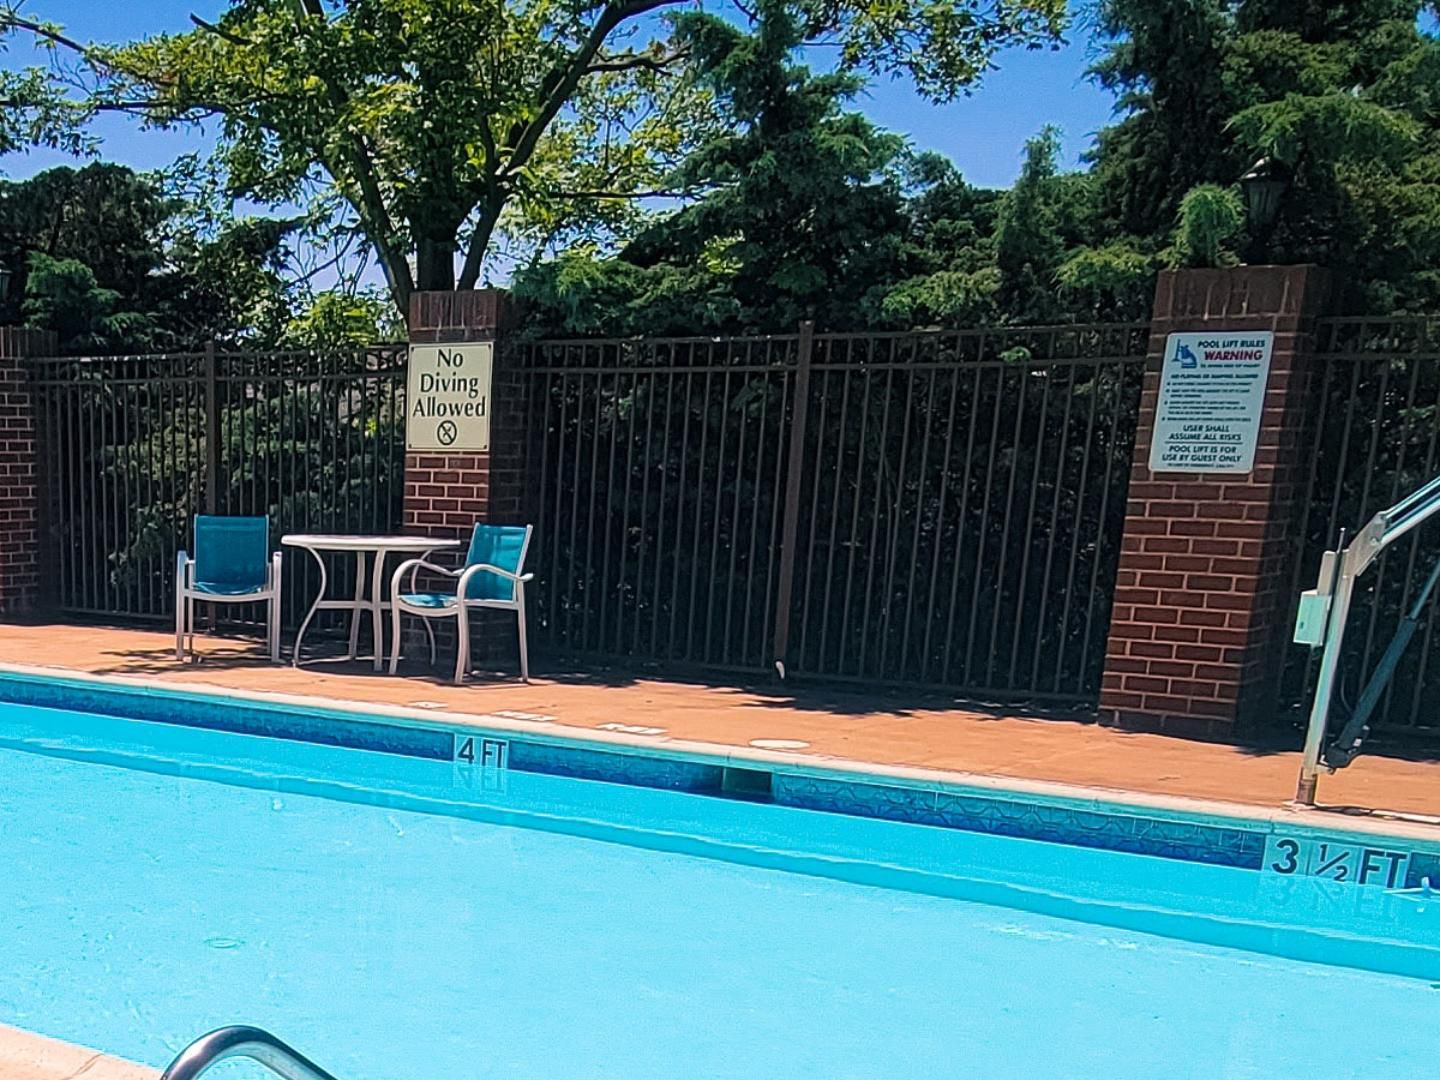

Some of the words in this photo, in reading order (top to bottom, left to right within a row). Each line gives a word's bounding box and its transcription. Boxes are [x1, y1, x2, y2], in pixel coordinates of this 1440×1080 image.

[1197, 340, 1220, 349] POOL
[1222, 340, 1239, 349] LIFT
[1240, 340, 1266, 348] RULES
[437, 348, 464, 367] No
[1204, 349, 1264, 361] WARNING
[420, 371, 479, 398] Diving
[412, 396, 486, 417] Allowed
[1168, 445, 1191, 453] POOL
[1192, 445, 1209, 453] LIFT
[1190, 454, 1217, 462] GUEST
[1218, 455, 1242, 463] ONLY
[457, 737, 474, 764] 4
[481, 739, 507, 768] FT
[1272, 839, 1299, 874] 3
[1359, 849, 1408, 888] FT
